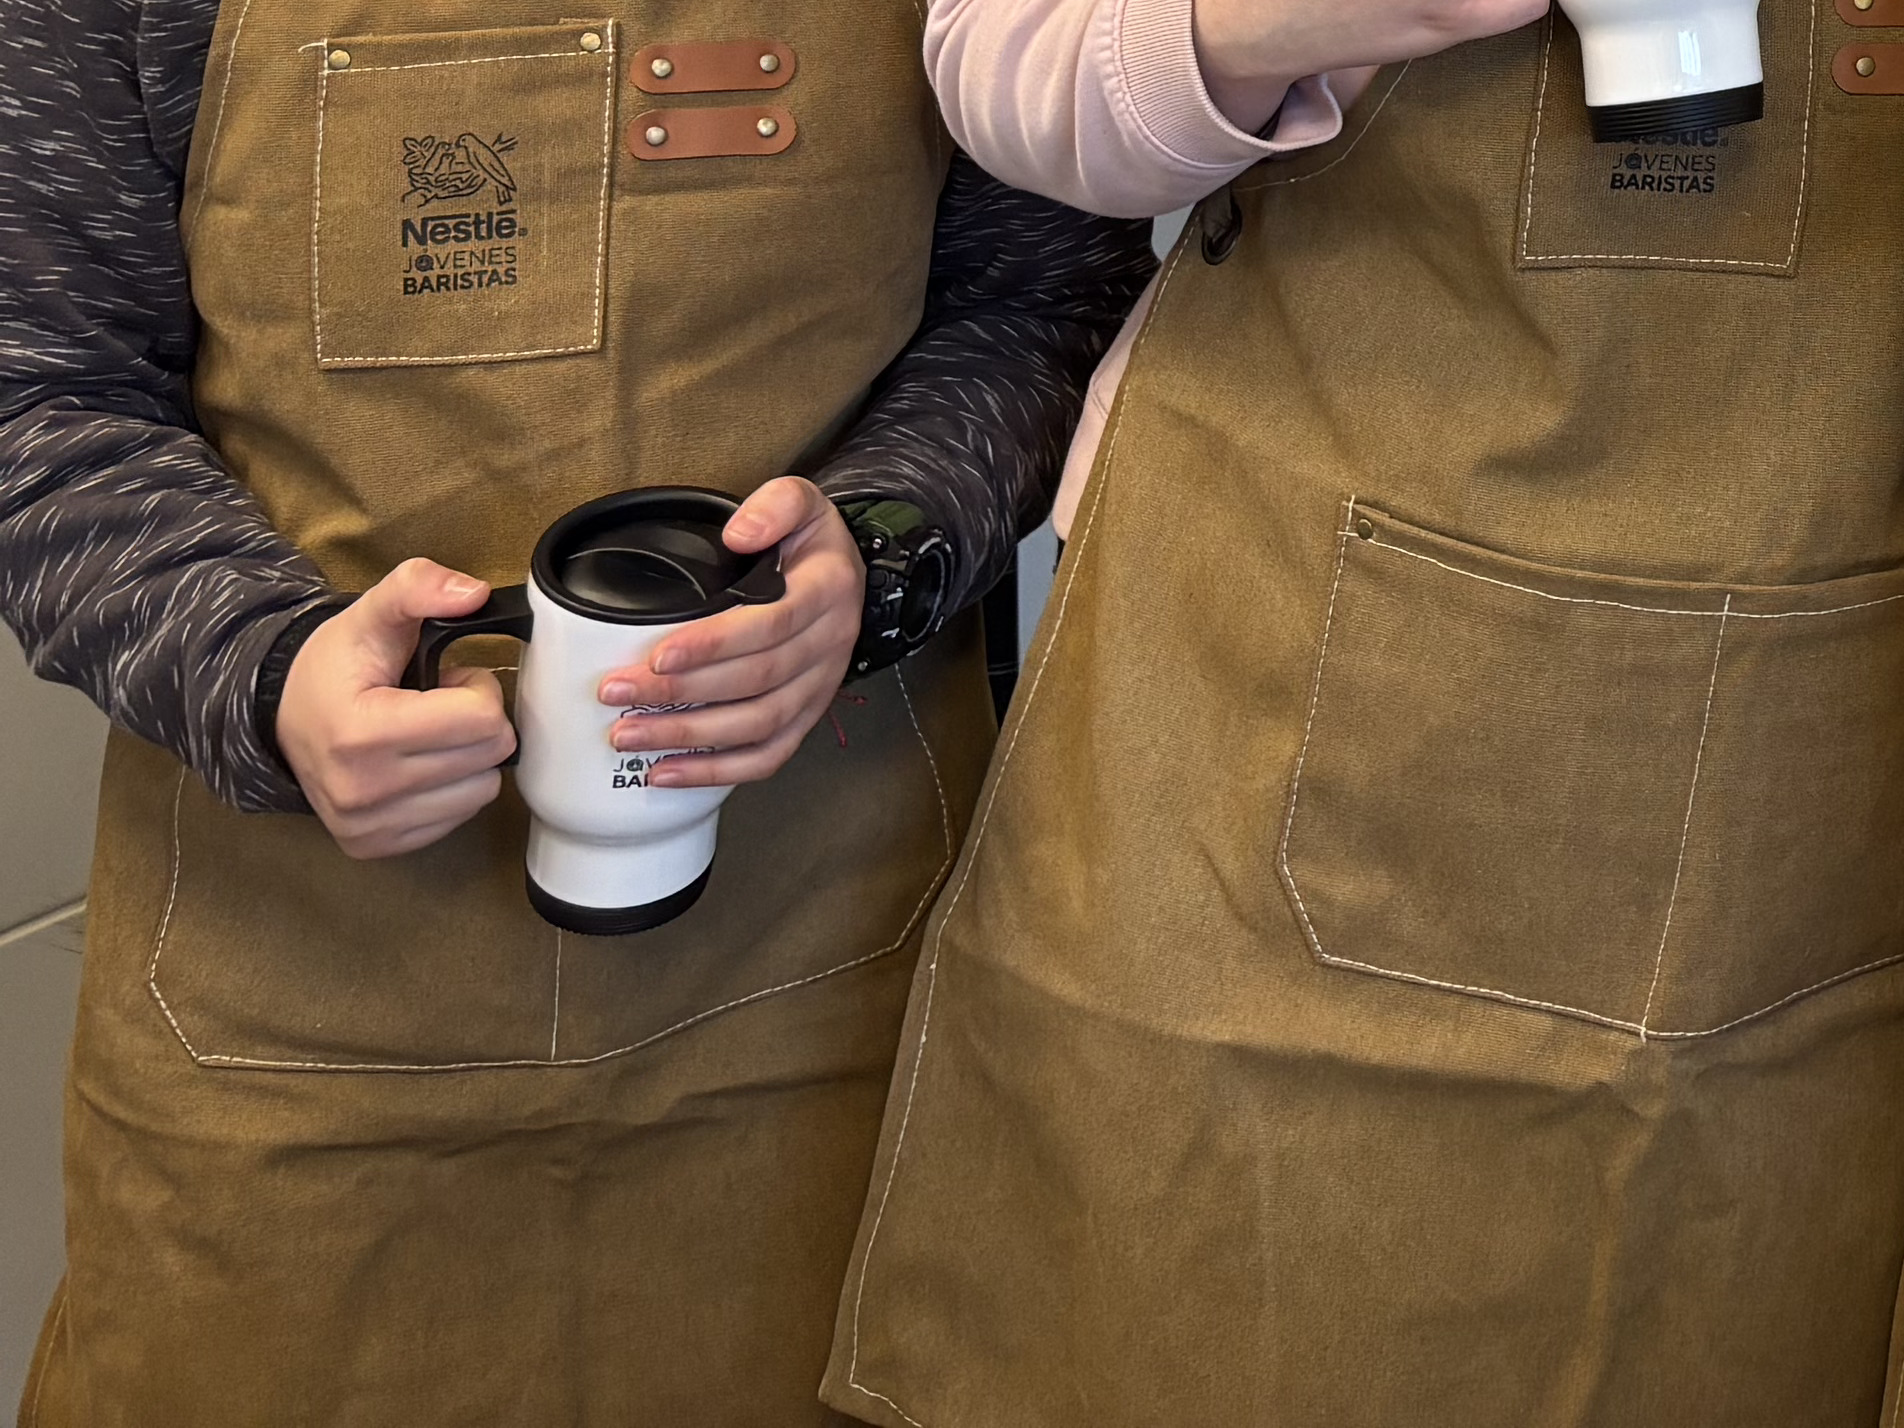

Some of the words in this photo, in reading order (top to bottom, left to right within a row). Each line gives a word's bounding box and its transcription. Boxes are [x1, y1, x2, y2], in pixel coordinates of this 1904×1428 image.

[1612, 148, 1716, 172] JÓVENES
[1610, 172, 1715, 194] BARISTAS
[401, 209, 518, 248] Nestlé
[402, 246, 518, 274] JÓVENES
[403, 267, 518, 296] BARISTAS
